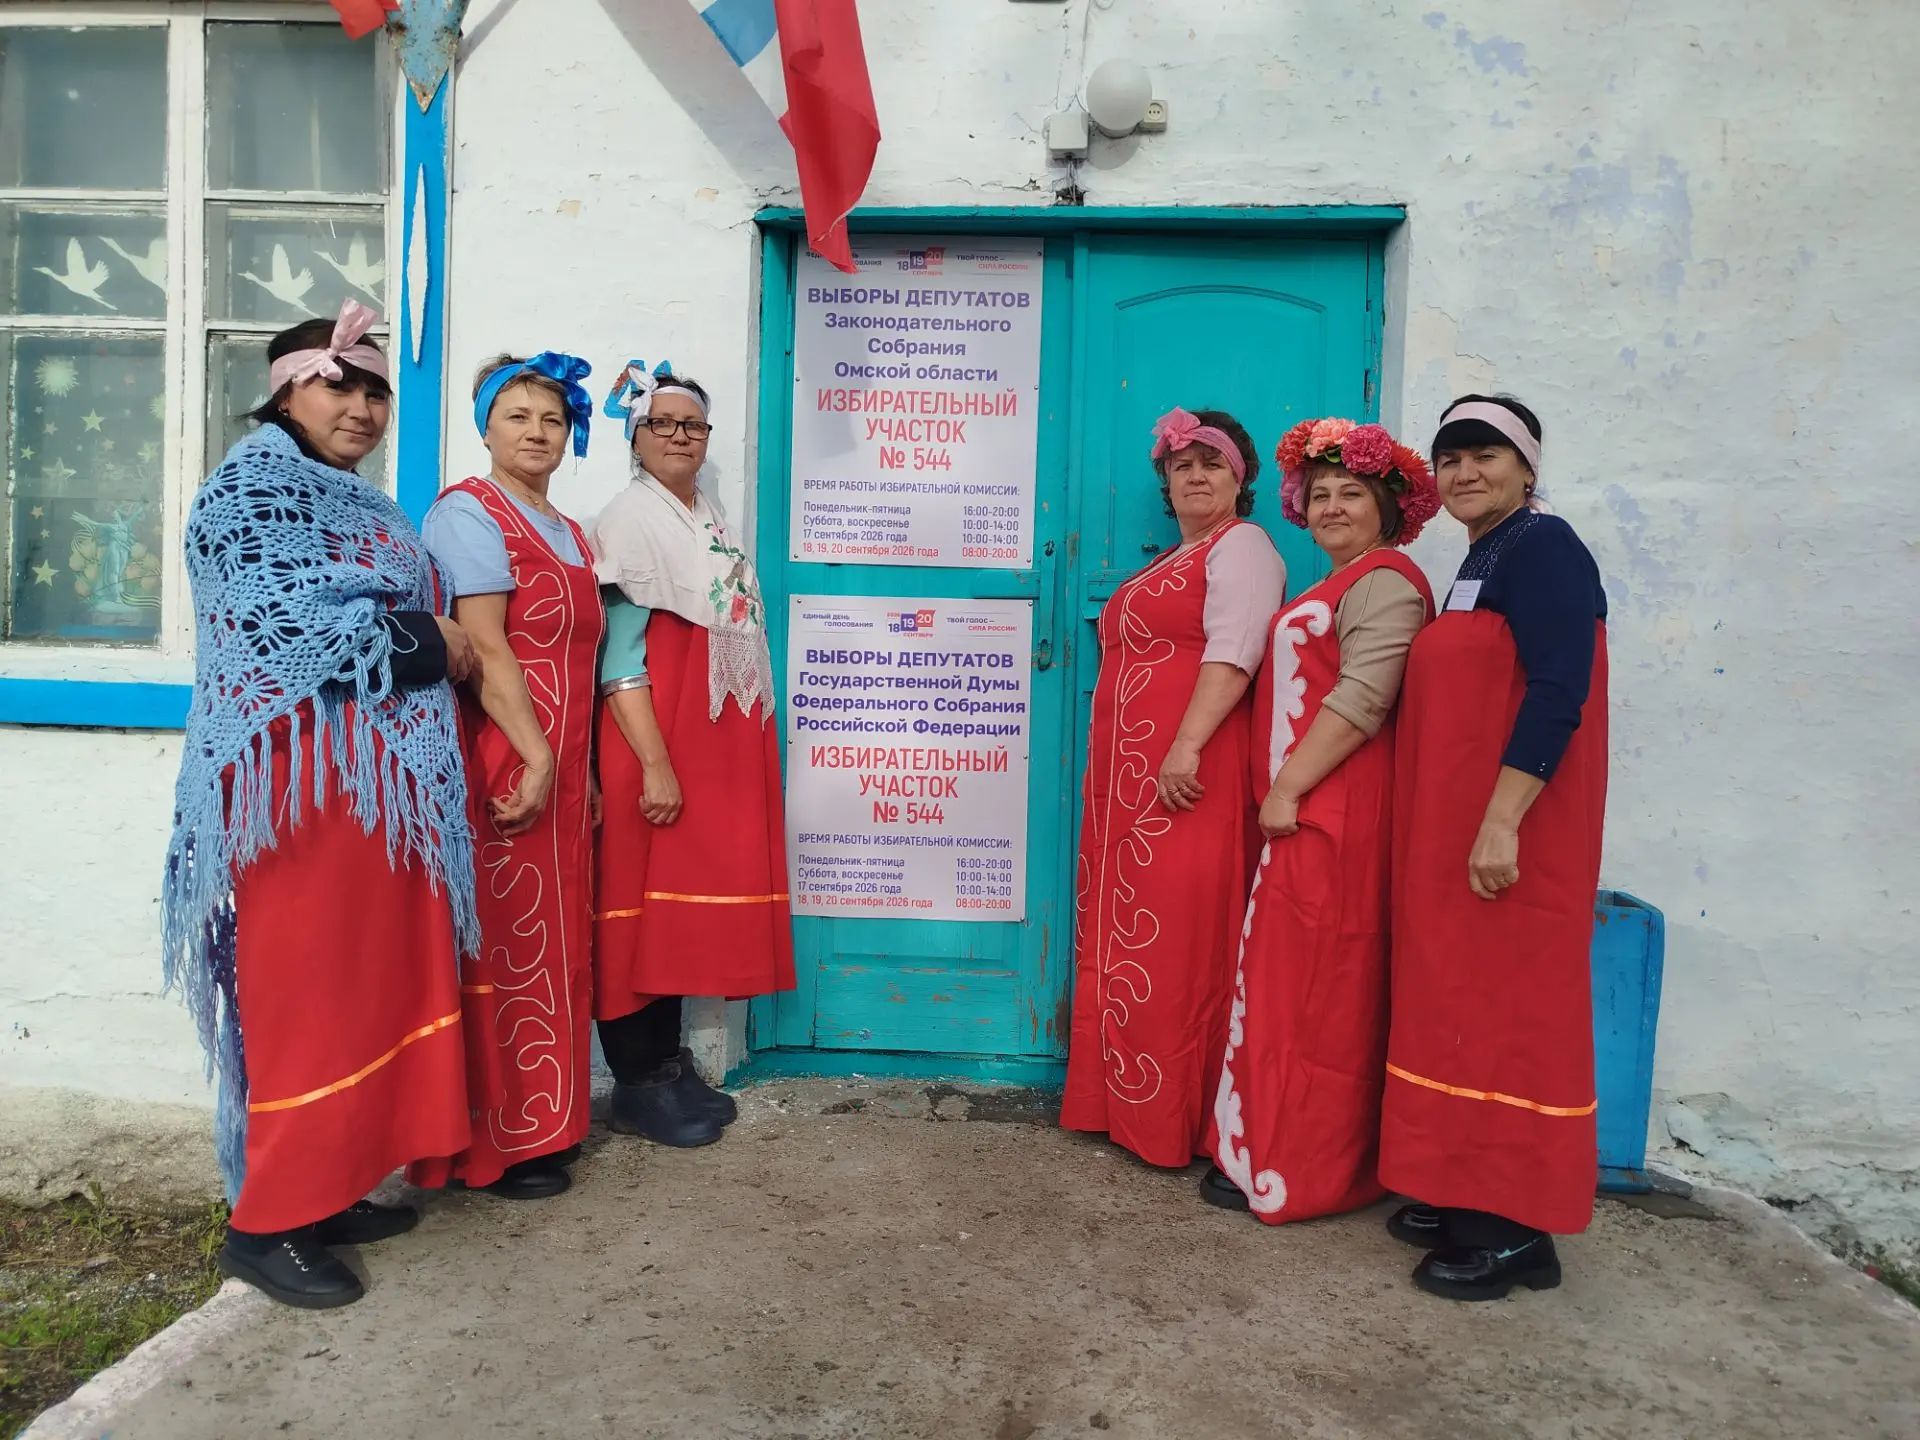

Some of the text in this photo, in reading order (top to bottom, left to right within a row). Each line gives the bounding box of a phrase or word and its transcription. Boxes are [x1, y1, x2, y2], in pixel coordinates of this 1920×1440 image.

[898, 261, 908, 270] 18
[808, 288, 1030, 308] ВЫБОРЫ ДЕПУТАТОВ
[825, 313, 1011, 332] Законодательного
[868, 338, 966, 357] Собрания
[835, 362, 998, 381] Омской области
[818, 389, 1017, 416] ИЗБИРАТЕЛЬНЫЙ
[866, 418, 966, 443] УЧАСТОК
[880, 447, 951, 471] № 544
[804, 480, 1020, 496] ВРЕМЯ РАБОТЫ ИЗБИРАТЕЛЬНОЙ КОМИССИИ:
[804, 502, 911, 515] Понедельник-пятница
[963, 506, 1019, 517] 16:00-20:00
[803, 515, 909, 529] Суббота, воскресенье
[963, 520, 1018, 531] 10:00-14:00
[803, 529, 907, 543] 17 сентября 2026 года
[963, 534, 1018, 545] 10:00-14:00
[803, 543, 938, 557] 18, 19, 20 сентября 2026 года
[962, 547, 1018, 559] 08:00-20:00
[903, 619, 914, 627] 19
[918, 614, 931, 623] 20
[888, 624, 899, 632] 18
[806, 650, 1014, 668] ВЫБОРЫ ДЕПУТАТОВ
[800, 672, 1019, 693] Государственной Думы
[792, 693, 1025, 716] Федерального Собрания
[797, 716, 1021, 737] Российской Федерации
[811, 745, 1008, 772] ИЗБИРАТЕЛЬНЫЙ
[859, 774, 958, 798] УЧАСТОК
[873, 801, 944, 824] № 544
[799, 833, 1012, 848] ВРЕМЯ РАБОТЫ ИЗБИРАТЕЛЬНОЙ КОМИССИИ:
[799, 855, 904, 868] Понедельник-пятница
[957, 858, 1011, 869] 16:00-20:00
[798, 868, 903, 881] Суббота, воскресенье
[956, 872, 1011, 883] 10:00-14:00
[798, 882, 901, 895] 17 сентября 2026 года
[956, 886, 1011, 896] 10:00-14:00
[798, 895, 932, 909] 18, 19, 20 сентября 2026 года
[956, 899, 1011, 910] 08:00-20:00
